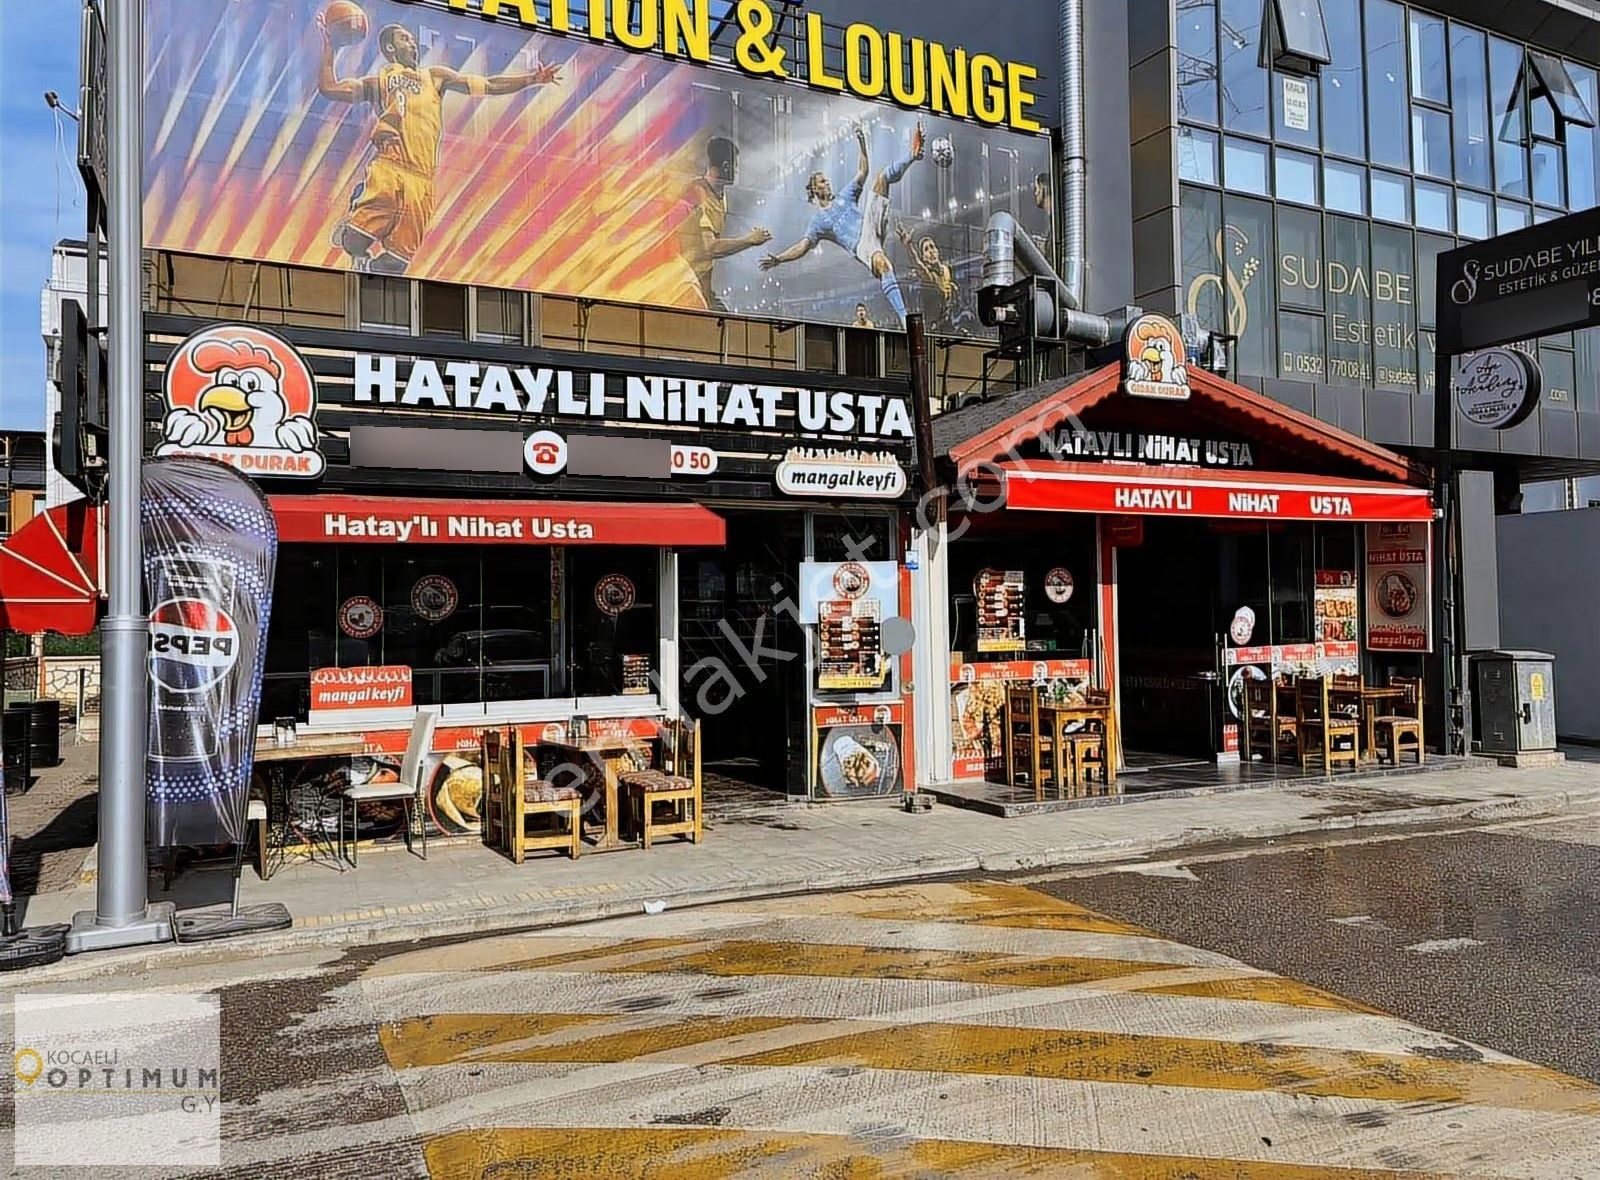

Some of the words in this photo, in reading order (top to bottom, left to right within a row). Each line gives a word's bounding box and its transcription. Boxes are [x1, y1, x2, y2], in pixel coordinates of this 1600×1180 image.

[736, 0, 789, 77] &
[807, 12, 1041, 132] LOUNGE
[1484, 247, 1562, 281] SUDABE
[1567, 234, 1600, 259] YIL
[1282, 255, 1411, 304] SUDABE
[1498, 273, 1547, 295] ESTETİK
[1333, 314, 1416, 350] Estetik
[1296, 355, 1323, 374] 0532
[354, 352, 605, 416] HATAYLI
[798, 388, 914, 437] USTA
[1039, 428, 1132, 458] HATAYLI
[1205, 440, 1253, 466] USTA
[241, 454, 311, 472] DURAK
[671, 451, 684, 468] 0
[689, 452, 710, 470] 50
[791, 470, 855, 489] mangal
[856, 470, 897, 491] keyfi
[1115, 487, 1192, 510] HATAYLI
[1309, 495, 1353, 516] USTA
[447, 516, 523, 539] Nihat
[532, 518, 594, 540] Usta
[319, 687, 370, 704] mangal
[371, 685, 405, 702] keyfi
